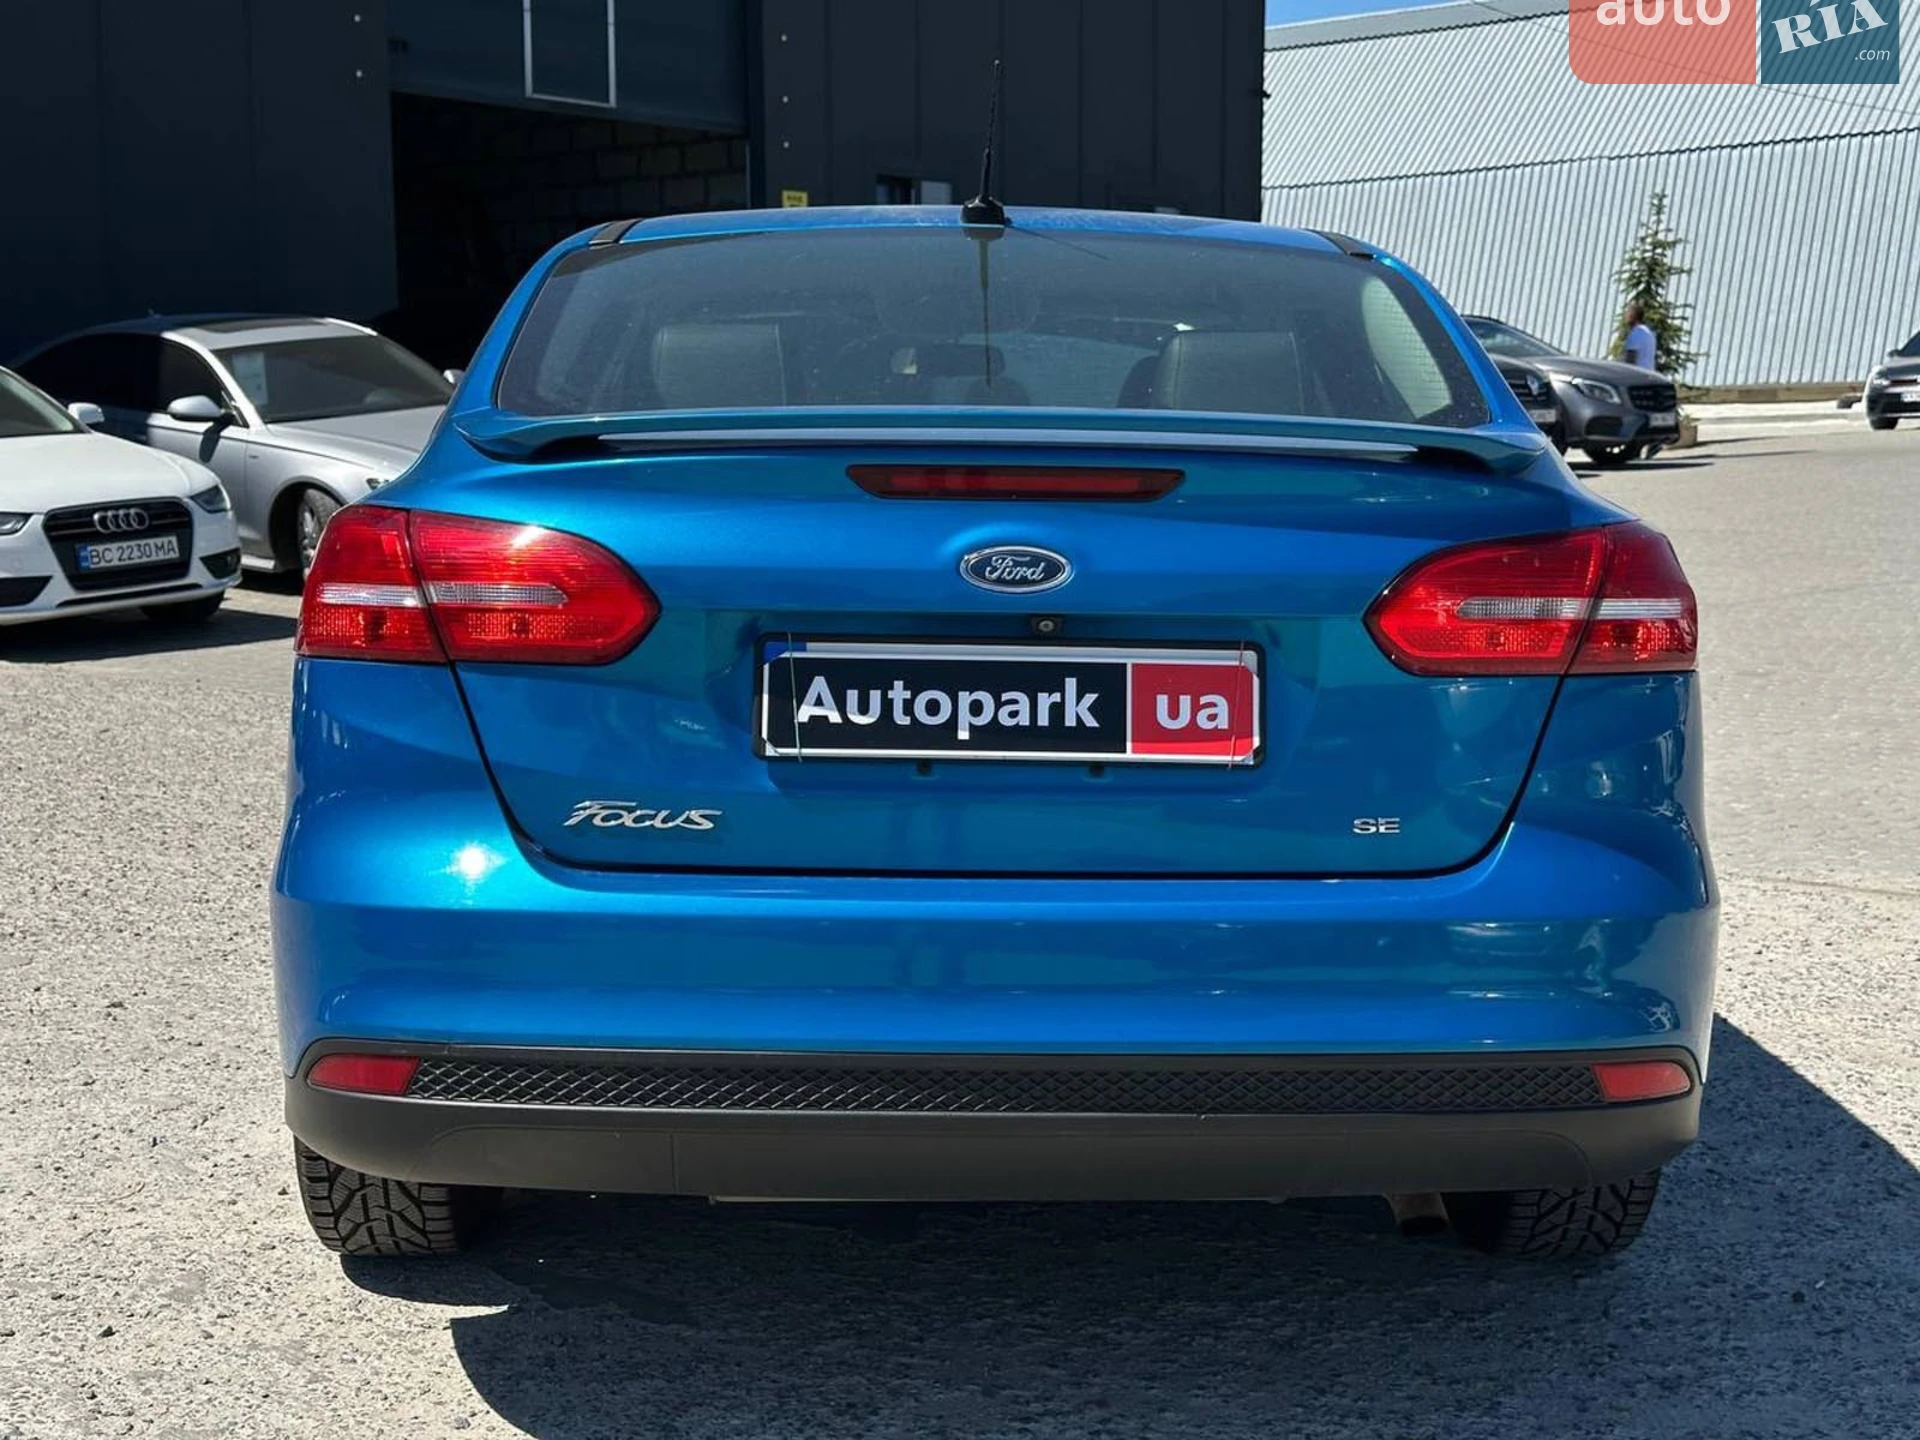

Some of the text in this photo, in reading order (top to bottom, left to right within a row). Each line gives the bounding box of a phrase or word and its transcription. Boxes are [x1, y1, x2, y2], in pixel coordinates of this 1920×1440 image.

[89, 540, 177, 566] BC 2230 MA
[984, 554, 1046, 581] Ford
[796, 675, 1231, 741] Autopark ua
[1352, 817, 1401, 835] SE
